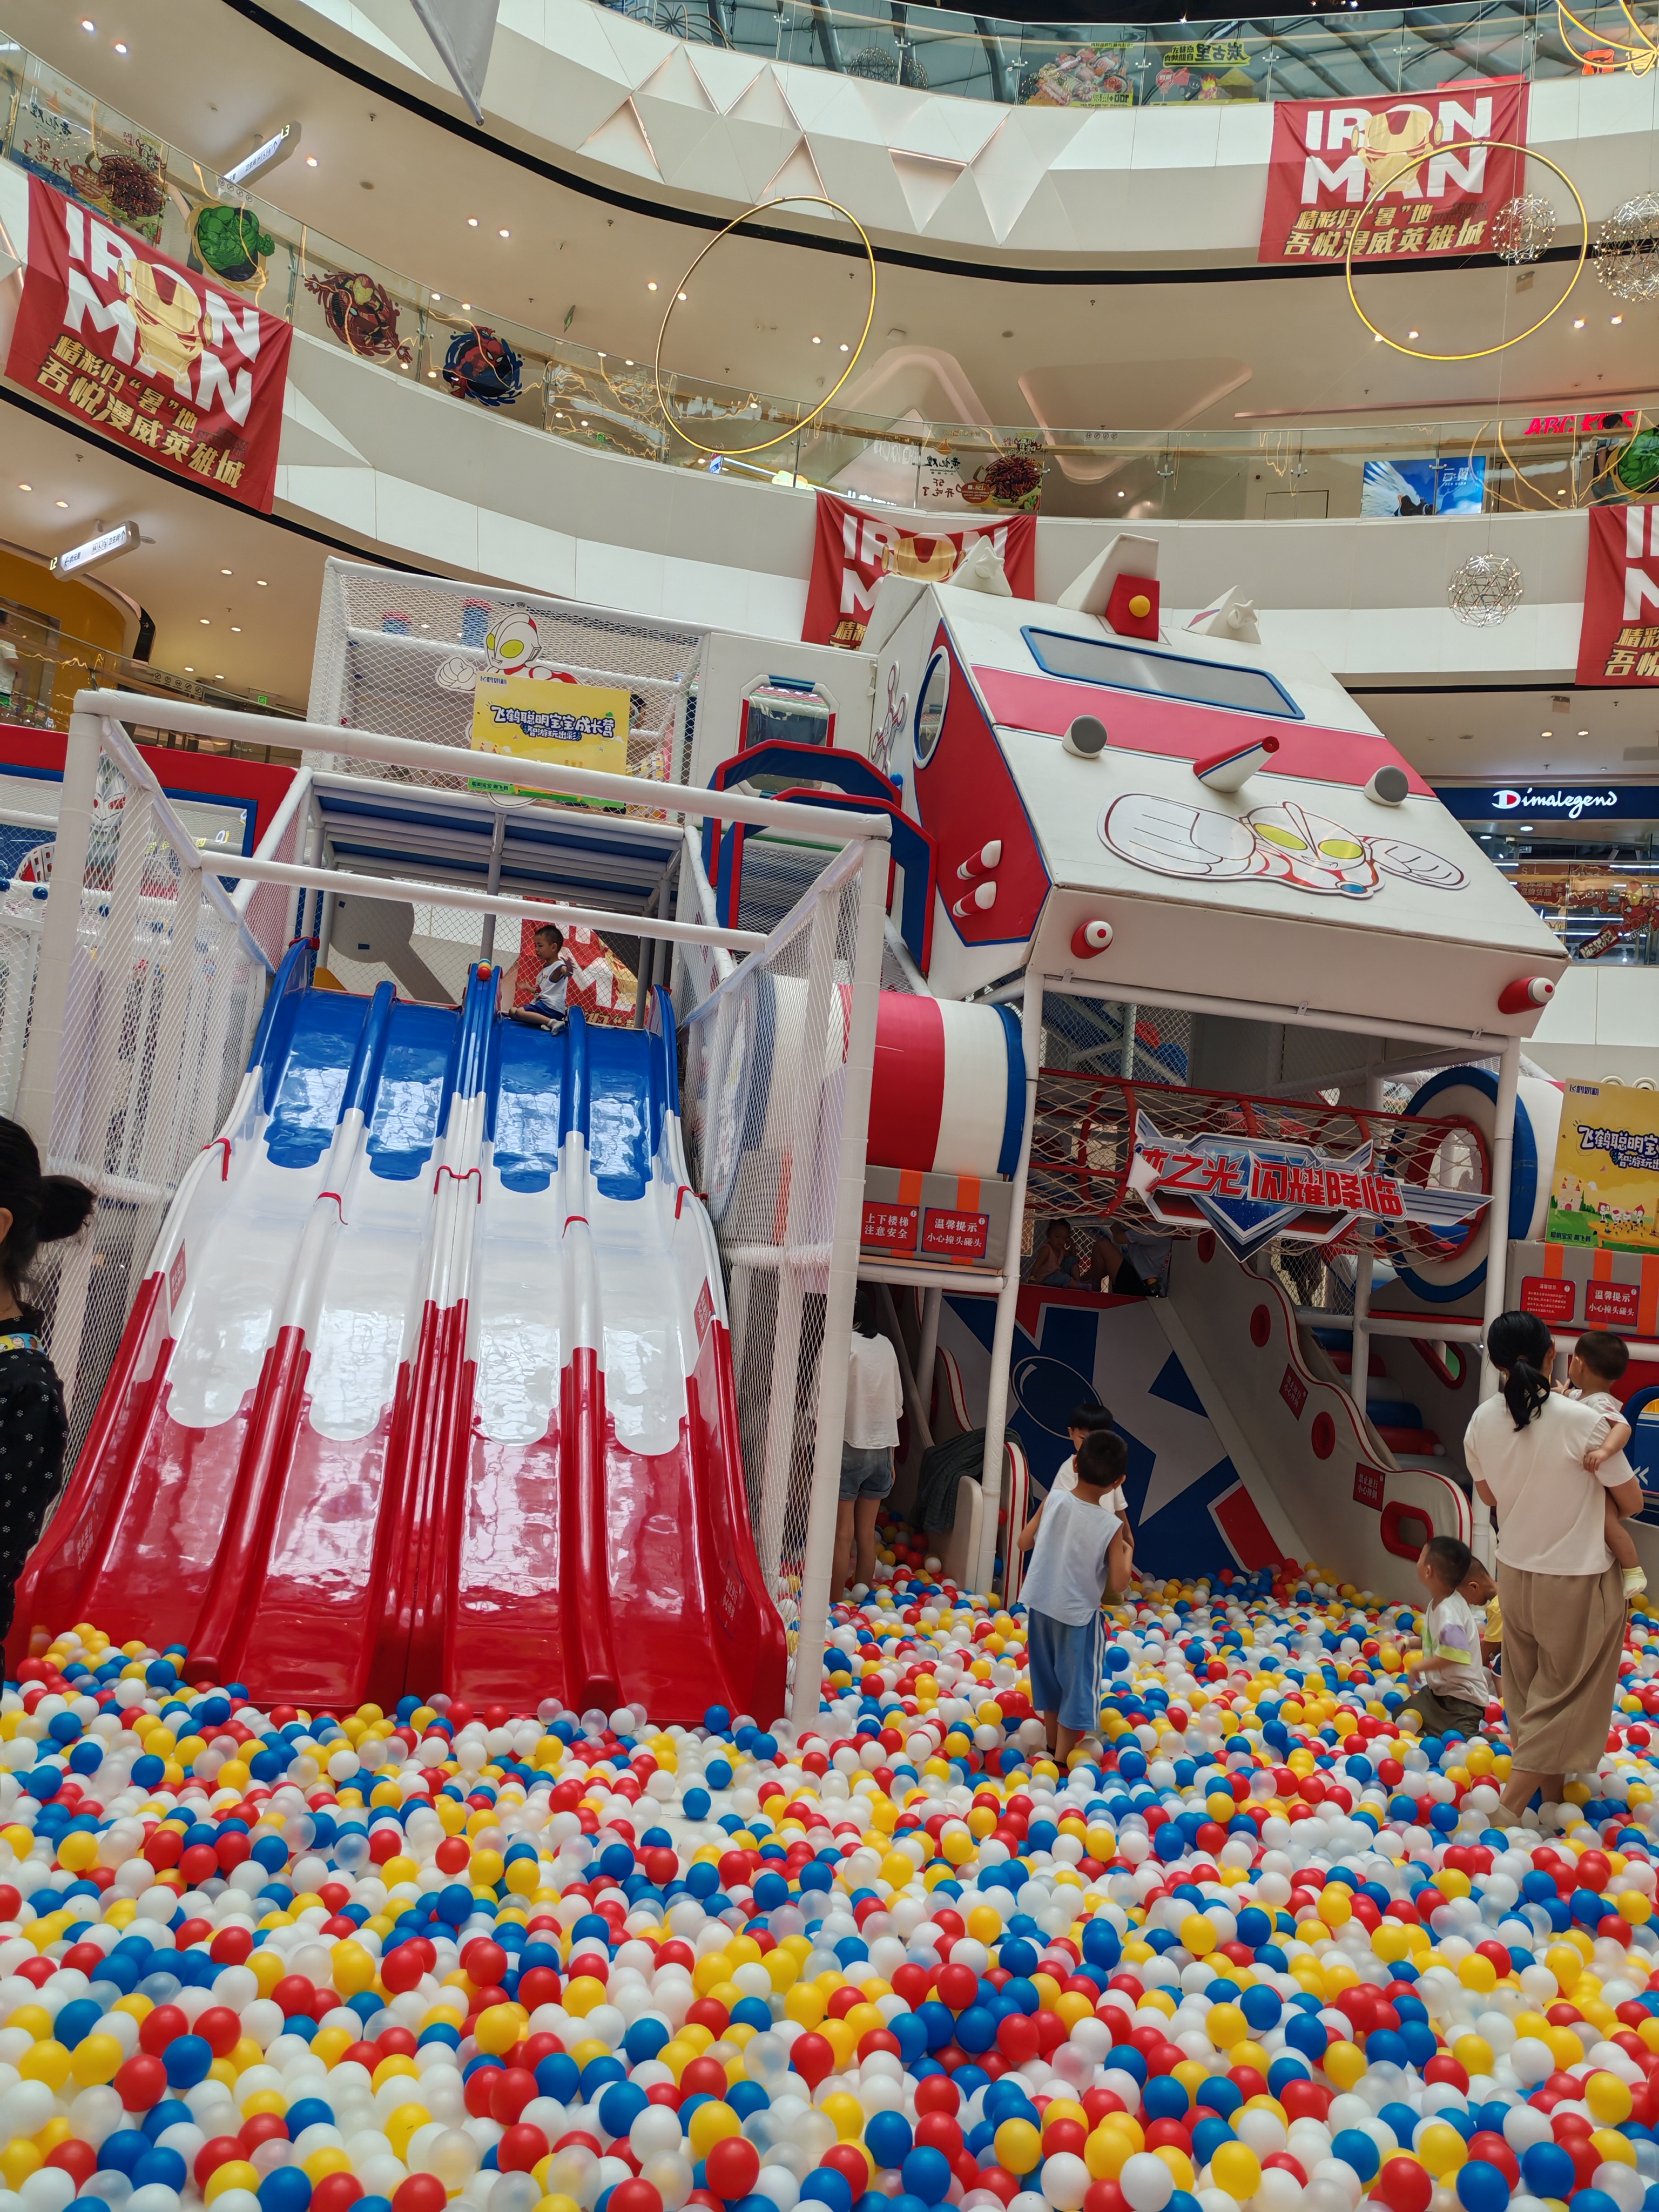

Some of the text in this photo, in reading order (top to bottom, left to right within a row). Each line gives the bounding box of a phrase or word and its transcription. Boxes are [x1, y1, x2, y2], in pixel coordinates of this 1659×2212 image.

[280, 124, 289, 139] L3
[1305, 97, 1492, 151] IRON
[1301, 145, 1487, 204] MAN
[1283, 217, 1488, 259] 吾悦漫威英雄城
[66, 201, 261, 364] IRON
[63, 267, 253, 427] MAN
[36, 353, 246, 489] 吾悦漫威英雄城
[1523, 415, 1575, 436] ABC
[50, 557, 58, 570] L2
[490, 705, 615, 738] 飞鹤聪明宝宝成长营
[1491, 787, 1617, 819] Dimalegend
[865, 1213, 909, 1227] 上下楼梯
[934, 1218, 978, 1232] 温馨提示
[865, 1224, 908, 1239] 注意安全
[926, 1232, 982, 1247] 小心撞头碰头
[1595, 1289, 1631, 1303] 温馨提示
[1588, 1303, 1634, 1317] 小心撞头碰头
